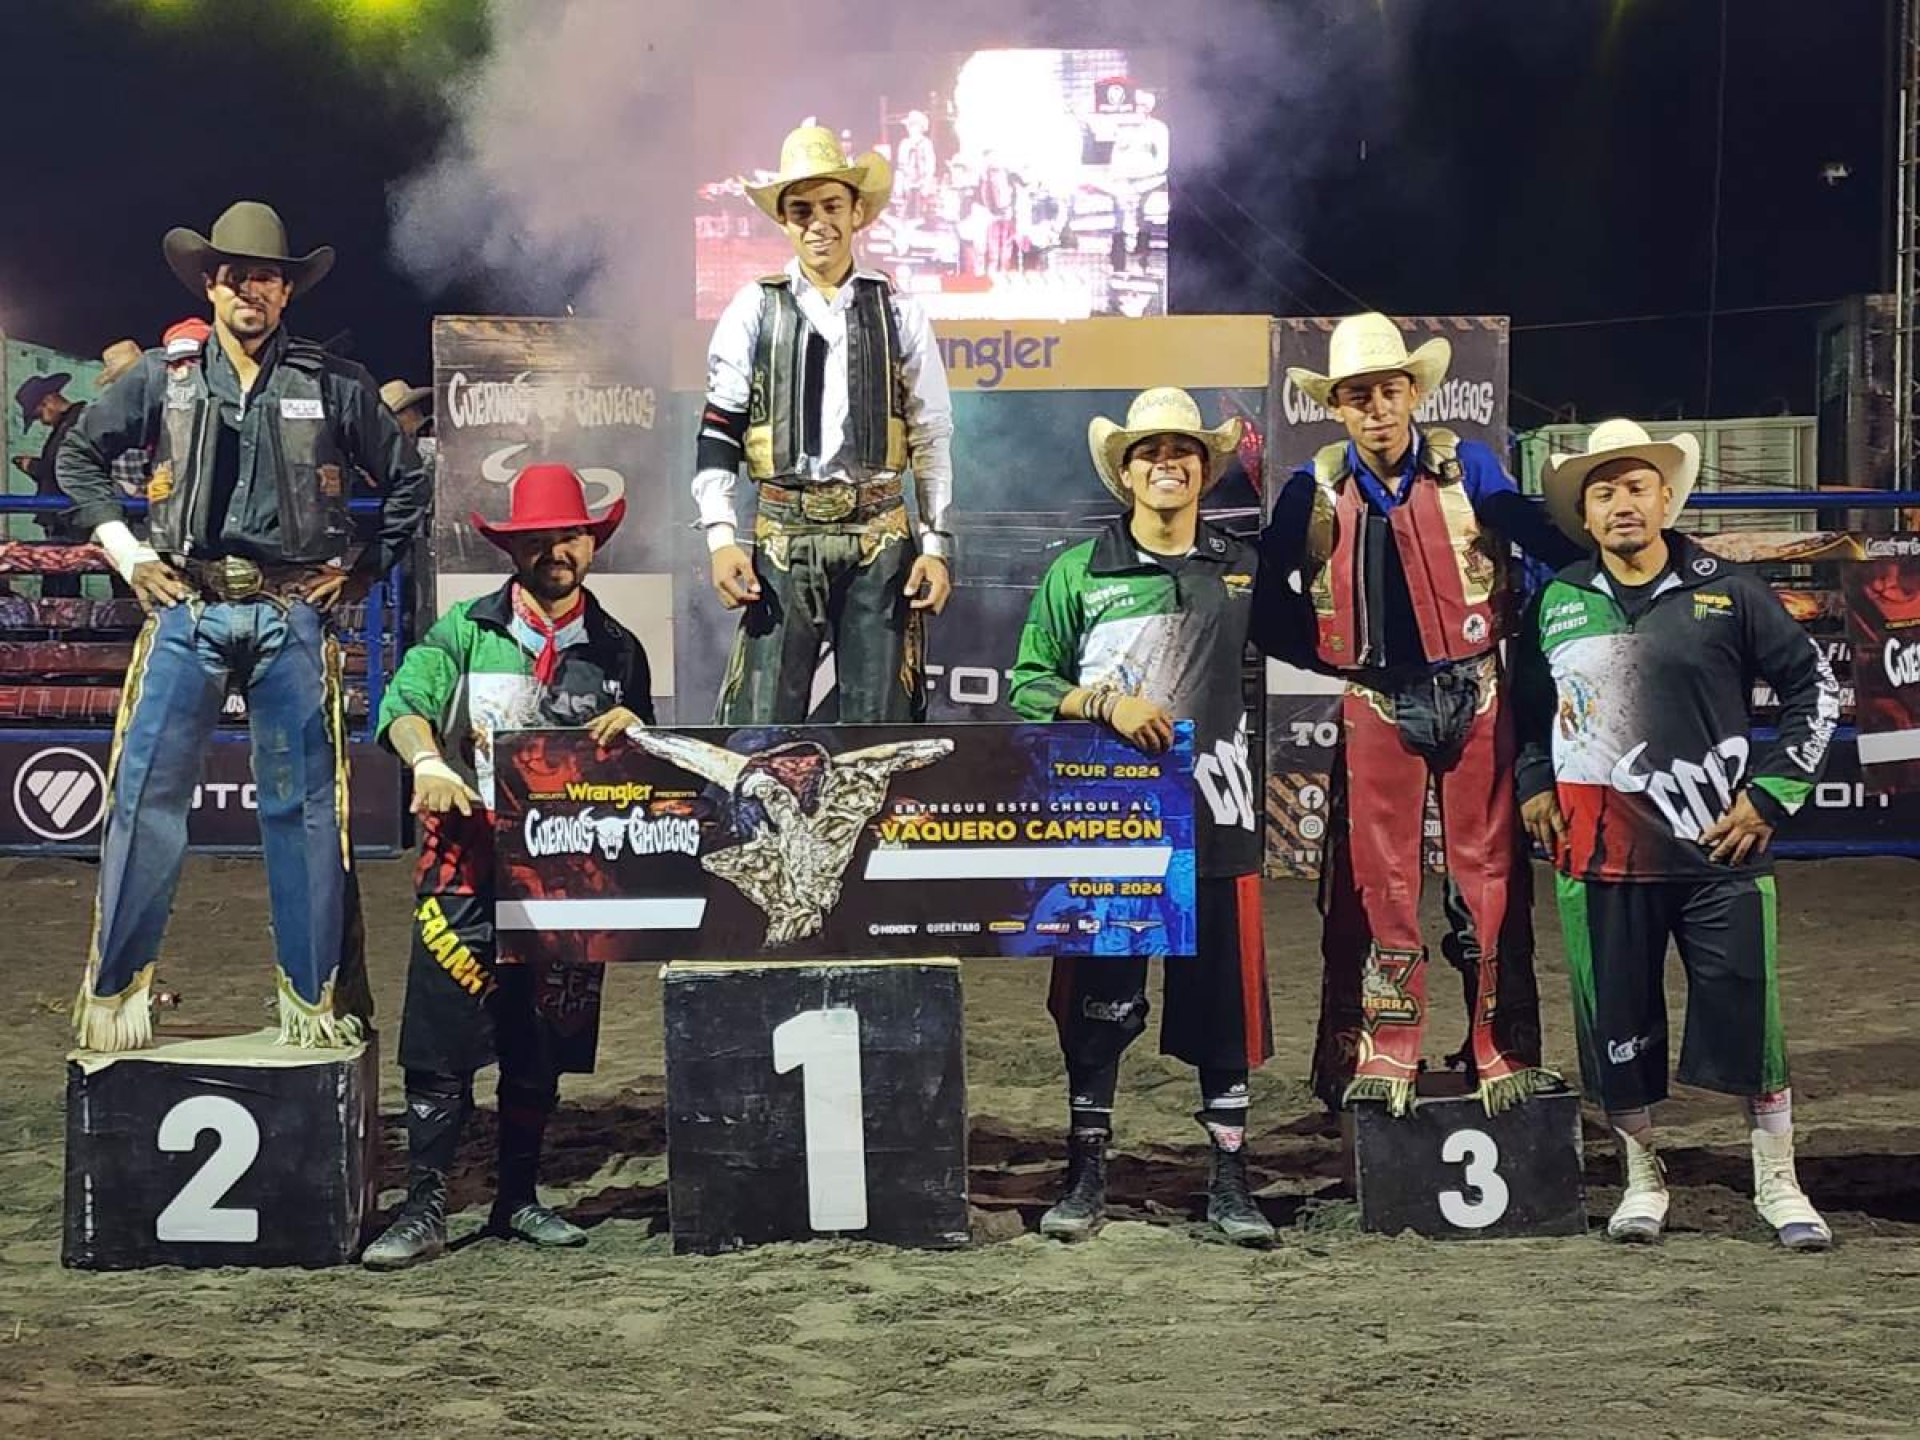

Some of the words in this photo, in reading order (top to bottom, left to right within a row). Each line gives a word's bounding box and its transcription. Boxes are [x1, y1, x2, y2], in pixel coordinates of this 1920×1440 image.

[936, 330, 1060, 388] ngler
[1291, 722, 1338, 747] TO
[1054, 763, 1107, 777] TOUR
[1113, 764, 1160, 778] 2024
[566, 782, 653, 809] Wrangler
[895, 803, 986, 814] ENTREGUE
[997, 802, 1039, 812] ESTE
[1050, 801, 1120, 812] CHEQUE
[1131, 801, 1153, 811] AL
[525, 806, 595, 857] CUERNOS
[880, 820, 1017, 841] VAQUERO
[1025, 814, 1163, 840] CAMPEÓN
[1068, 882, 1114, 895] TOUR
[1120, 882, 1163, 895] 2024
[773, 1008, 868, 1231] 1
[156, 1096, 259, 1243] 2
[1439, 1129, 1509, 1228] 3
